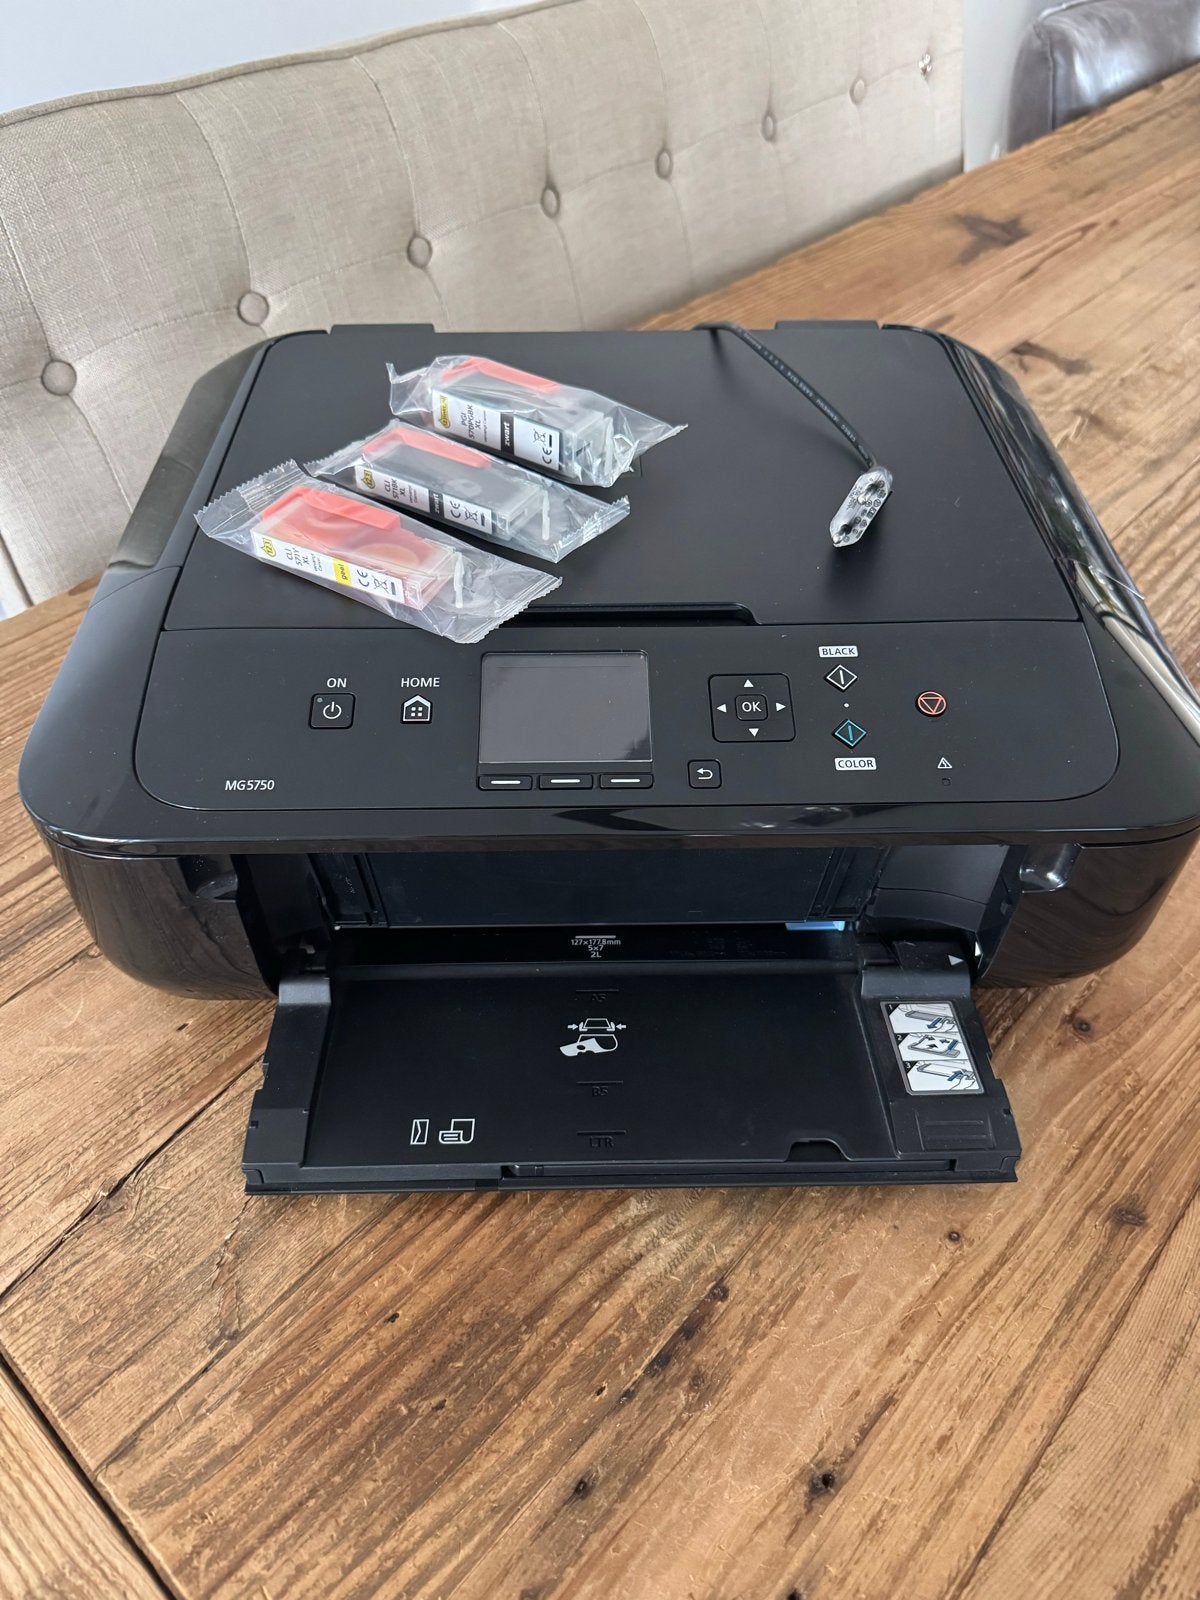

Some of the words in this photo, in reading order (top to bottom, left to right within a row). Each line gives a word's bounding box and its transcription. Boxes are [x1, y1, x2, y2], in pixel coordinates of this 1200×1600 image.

[475, 420, 481, 430] XL
[400, 487, 406, 497] XL
[294, 547, 302, 566] 571Y
[302, 556, 310, 565] XL
[340, 563, 348, 581] geel
[822, 647, 856, 656] BLACK
[326, 677, 347, 688] ON
[400, 677, 440, 688] HOME
[741, 701, 762, 713] OK
[838, 759, 874, 769] COLOR
[224, 779, 275, 791] MG5750
[589, 1136, 614, 1148] LTR
